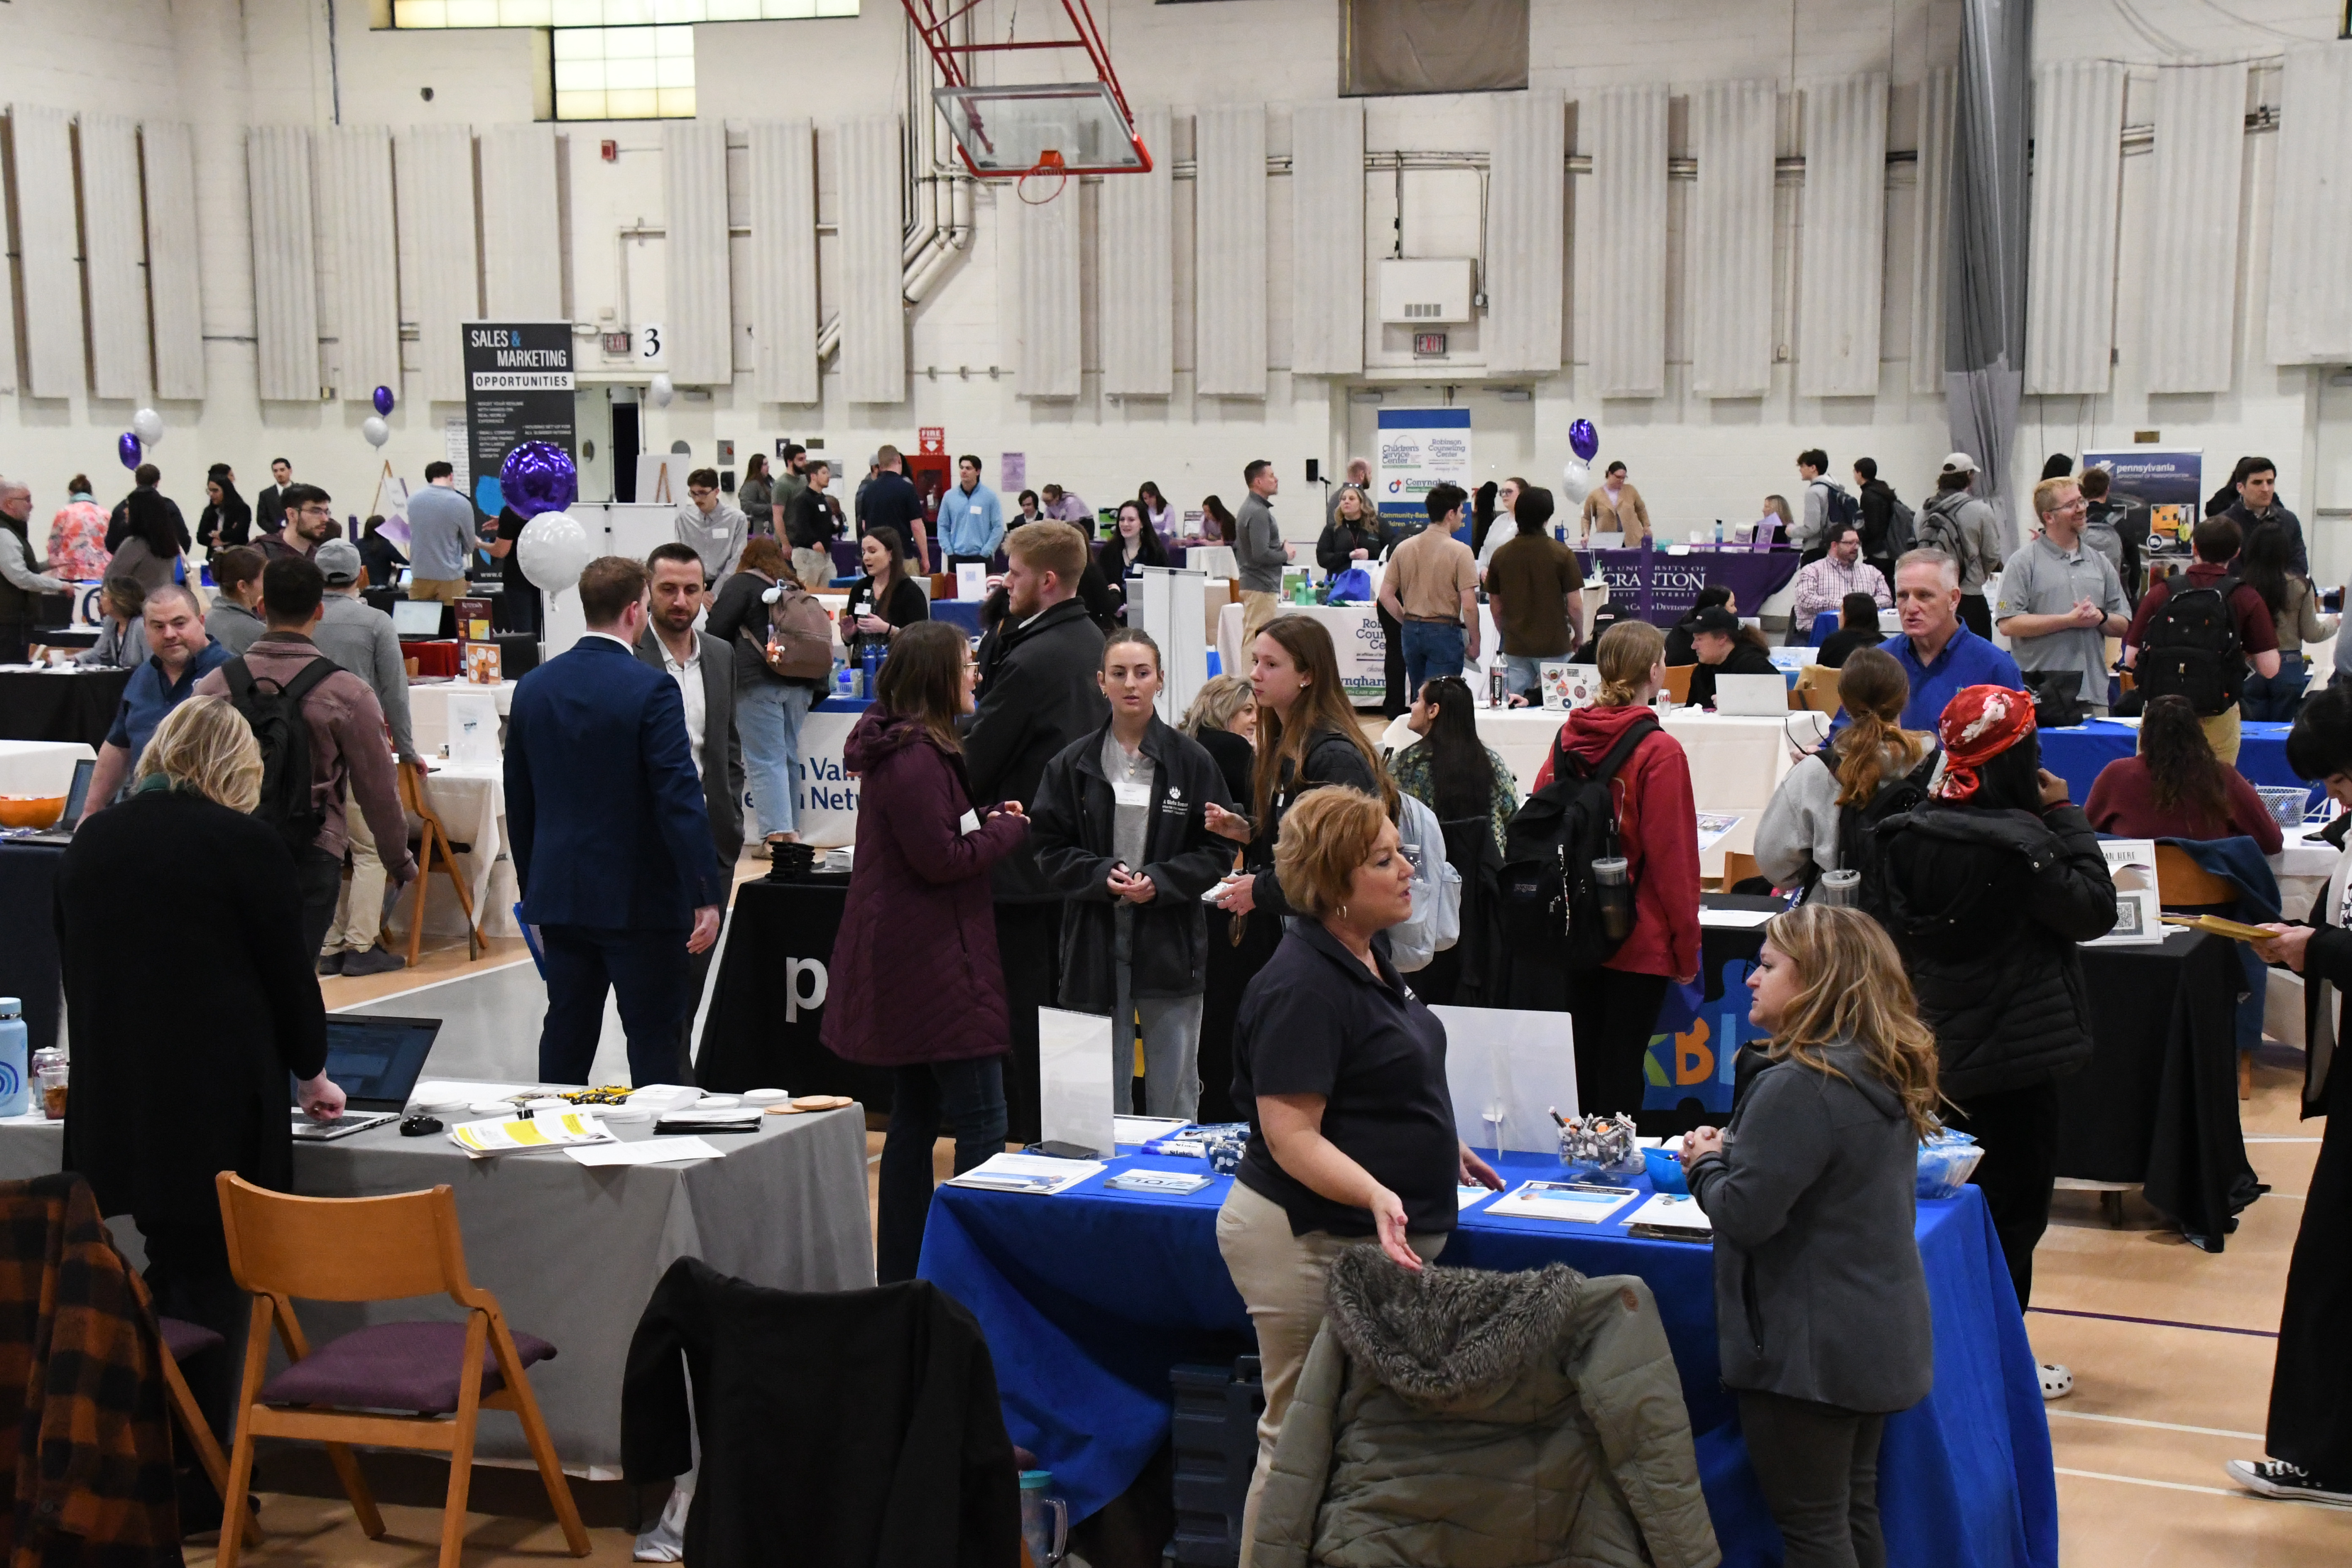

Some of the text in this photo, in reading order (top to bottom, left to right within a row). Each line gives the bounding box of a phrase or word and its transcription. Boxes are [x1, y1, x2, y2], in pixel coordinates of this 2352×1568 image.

[471, 330, 521, 348] SALES &
[607, 335, 627, 351] EXIT
[644, 328, 660, 357] 3
[1418, 335, 1443, 352] EXIT
[497, 350, 567, 367] MARKETING
[476, 376, 568, 387] OPPORTUNITIES
[2117, 463, 2175, 474] pennsylvania
[2117, 852, 2135, 860] HERE
